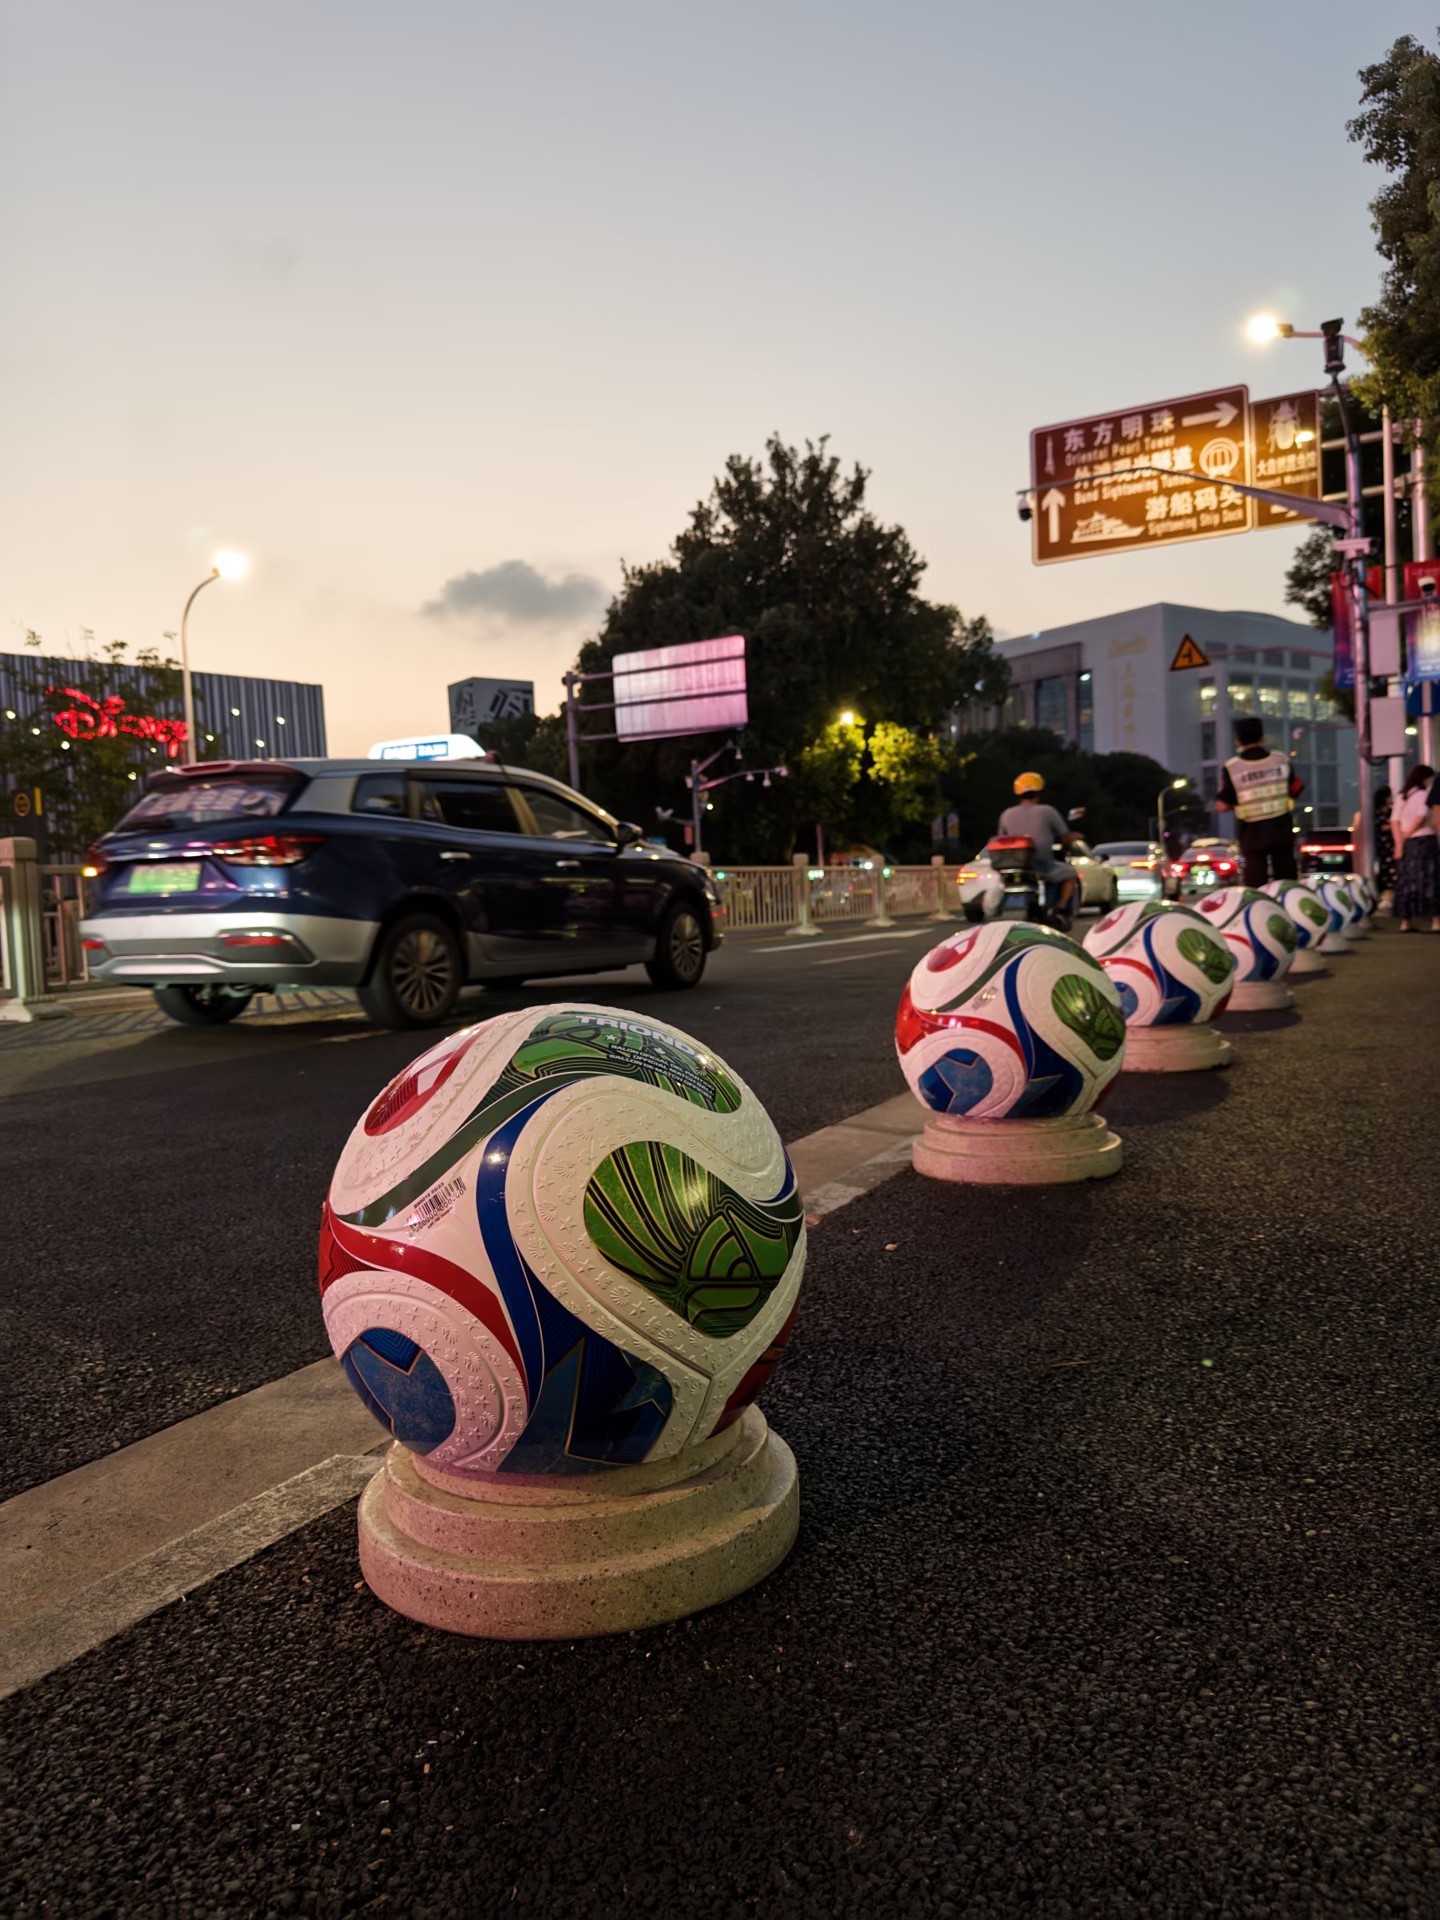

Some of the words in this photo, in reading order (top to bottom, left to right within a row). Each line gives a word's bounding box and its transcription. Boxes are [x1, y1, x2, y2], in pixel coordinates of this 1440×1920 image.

[1063, 409, 1174, 451] 东方明珠
[1065, 447, 1108, 466] Oriental
[1112, 440, 1141, 457] Pearl
[1074, 487, 1099, 505] Bund
[1145, 484, 1243, 521] 游船码头
[1200, 512, 1220, 527] Ship
[609, 1054, 643, 1067] BALLON
[654, 1067, 683, 1085] MATCH
[633, 1054, 668, 1072] OFFICIAL
[669, 1067, 697, 1084] MATCH
[697, 1082, 715, 1096] BALL
